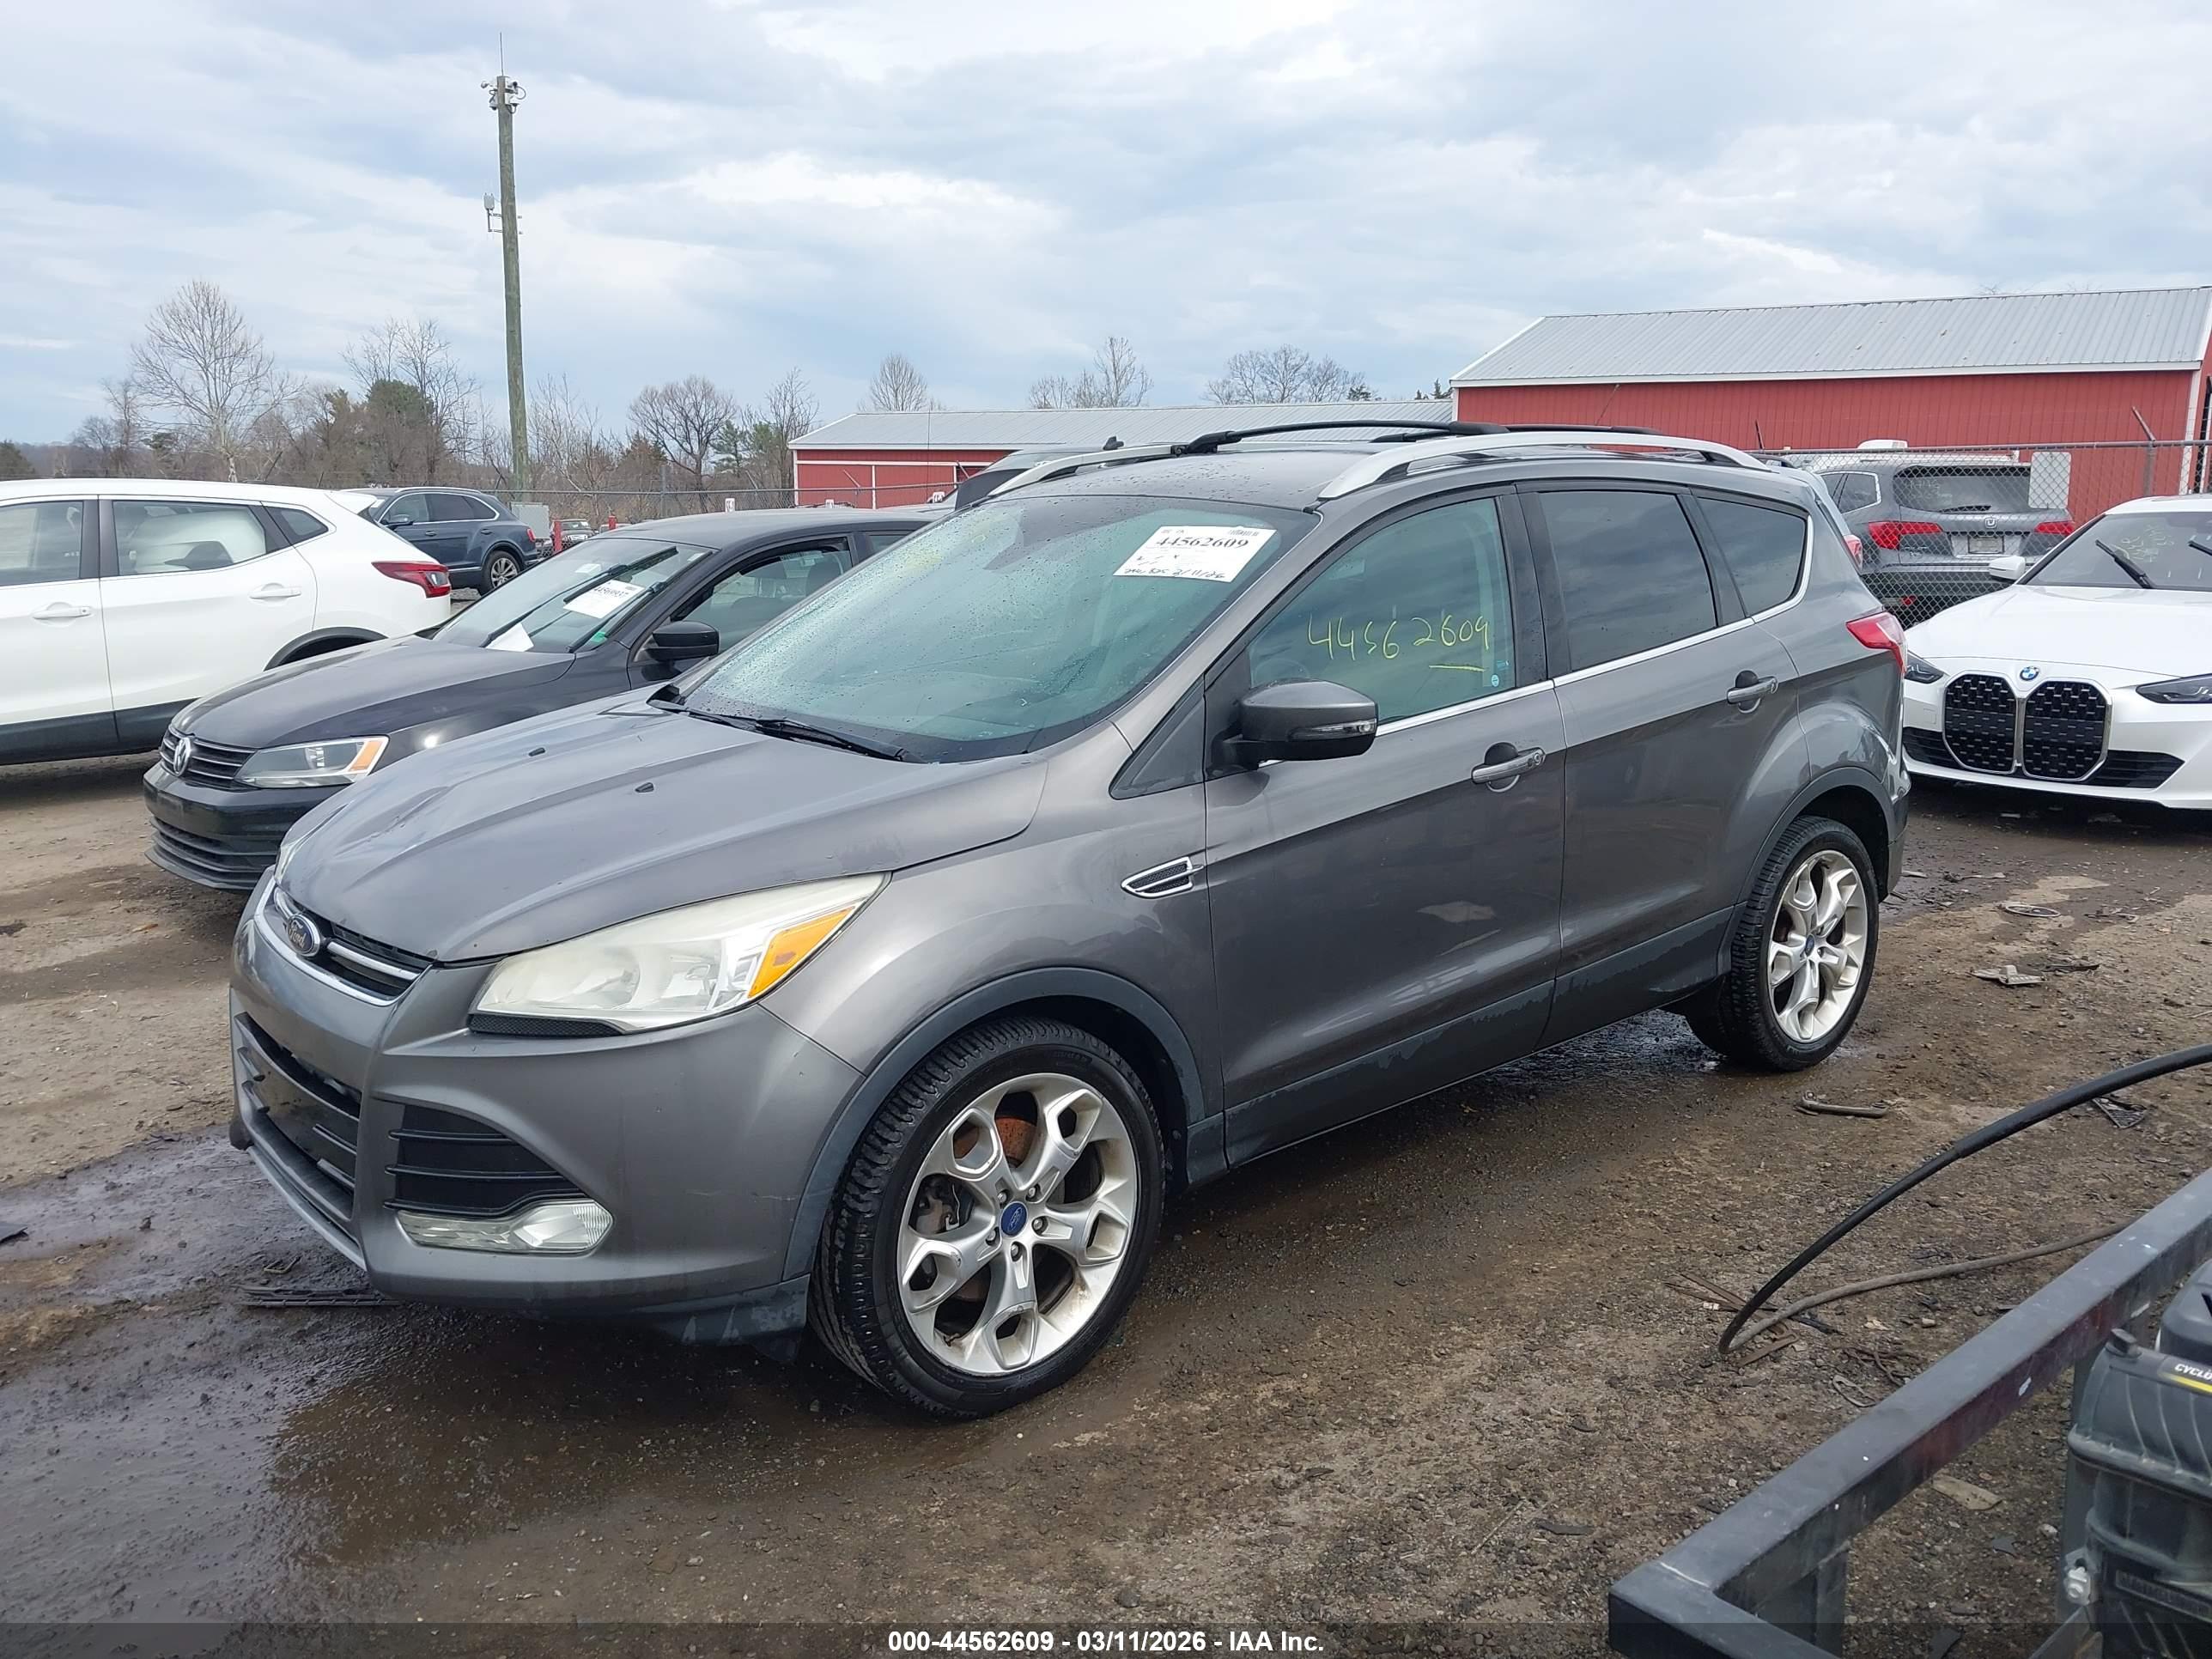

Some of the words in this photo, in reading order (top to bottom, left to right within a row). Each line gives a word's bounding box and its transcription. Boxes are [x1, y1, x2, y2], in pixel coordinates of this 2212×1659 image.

[1155, 536, 1249, 549] 44562609
[288, 919, 307, 950] Ford
[2173, 1363, 2212, 1381] CYCLO
